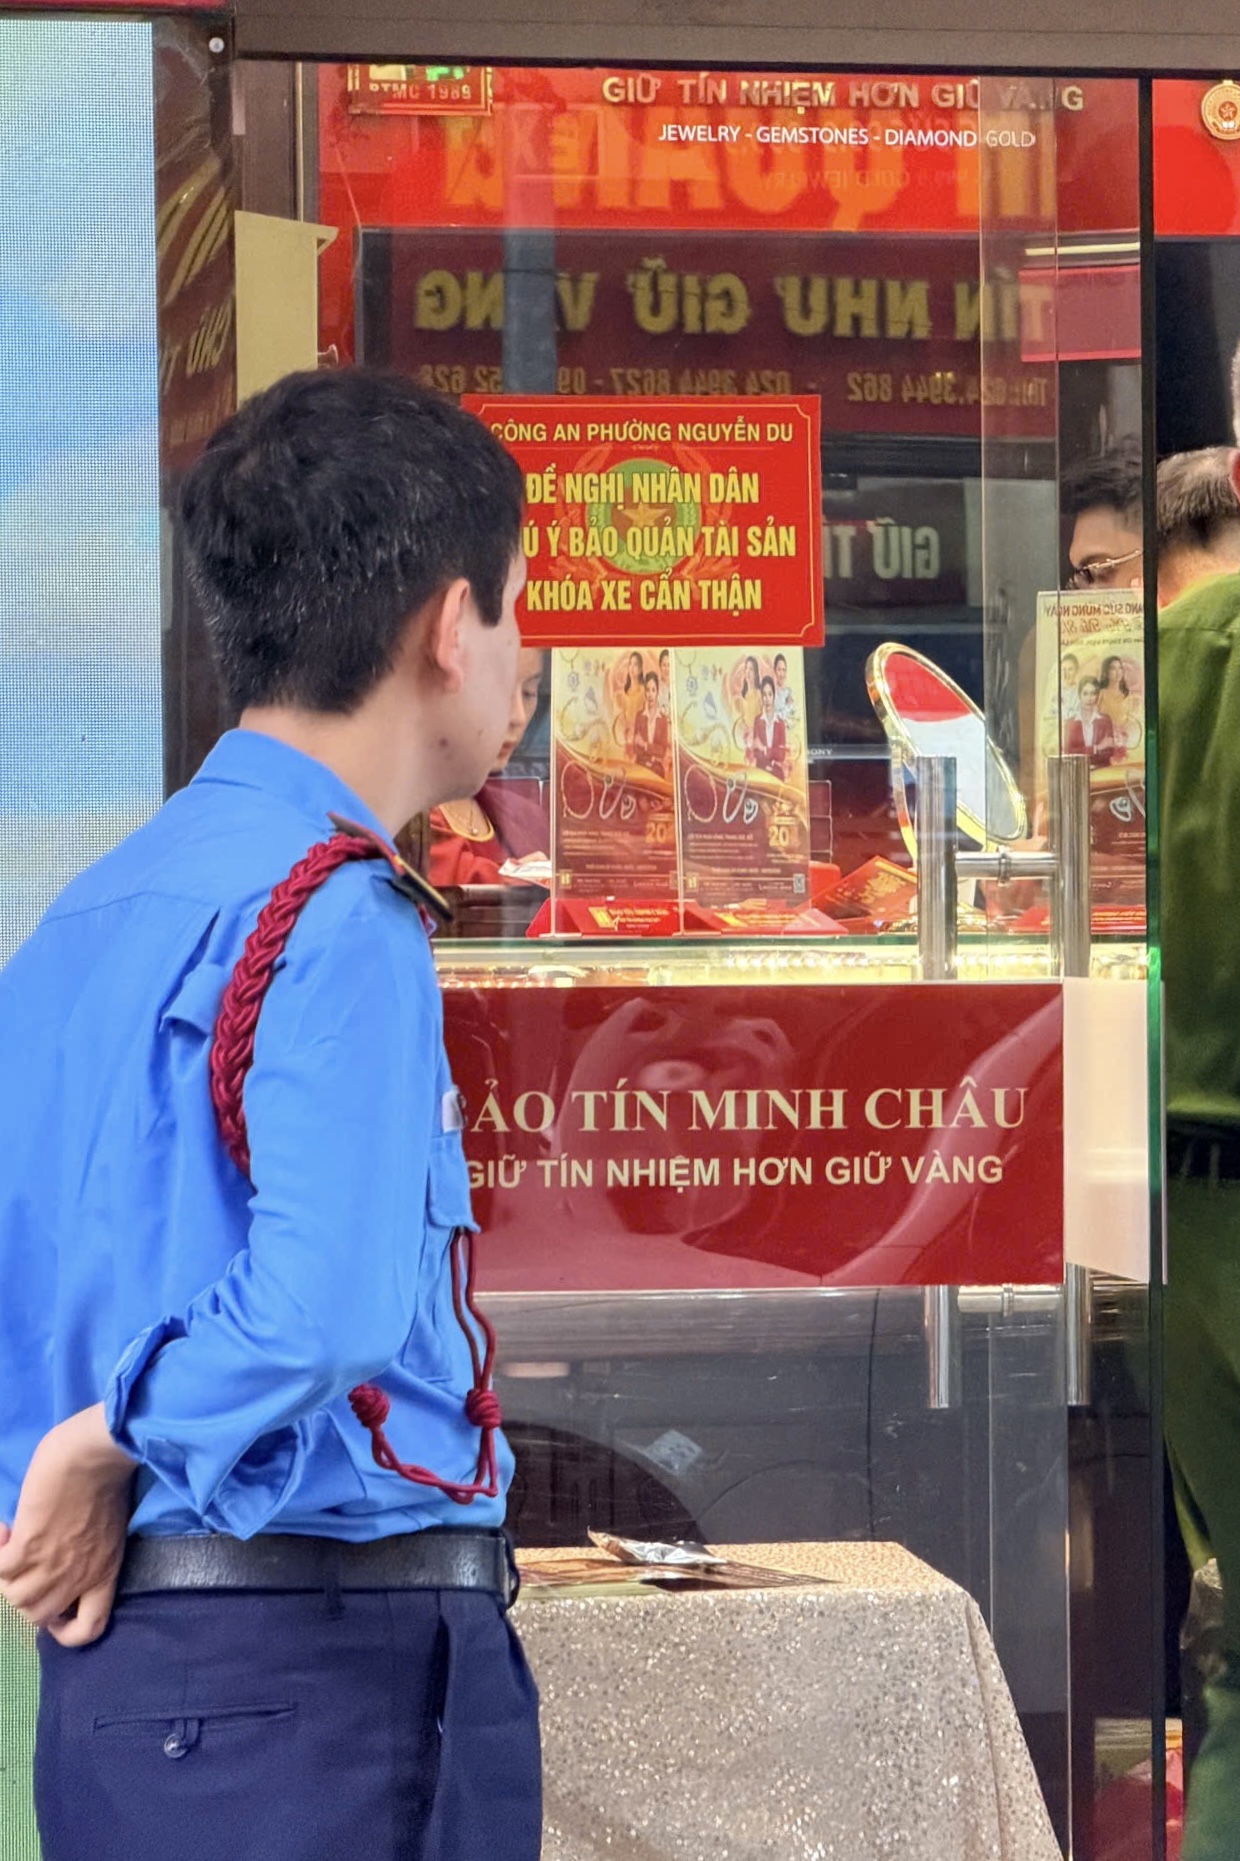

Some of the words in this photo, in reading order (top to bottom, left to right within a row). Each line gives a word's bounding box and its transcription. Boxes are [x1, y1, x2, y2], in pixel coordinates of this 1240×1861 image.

[677, 72, 727, 105] TÍN
[658, 124, 742, 142] JEWELRY
[756, 126, 869, 145] GEMSTONES
[885, 128, 977, 148] DIAMOND
[986, 130, 1036, 148] GOLD
[554, 422, 580, 442] AN
[587, 417, 672, 442] PHƯỜNG
[678, 415, 760, 442] NGUYỄN
[767, 422, 794, 442] DU
[565, 472, 624, 510] NGHỊ
[632, 465, 701, 504] NHÂN
[710, 465, 760, 504] DÂN
[547, 520, 562, 557] Ý
[569, 516, 618, 558] BẢO
[626, 515, 694, 560] QUẢN
[702, 518, 739, 557] TÀI
[747, 515, 796, 557] SẢN
[527, 573, 594, 611] KHÓA
[601, 579, 632, 611] XE
[640, 567, 691, 611] CẨN
[698, 573, 762, 616] THẬN
[806, 748, 832, 756] ONY
[469, 1078, 556, 1133] ẢO
[571, 1077, 669, 1132] TÍN
[688, 1087, 846, 1132] MINH
[864, 1075, 1027, 1131] CHÂU
[467, 1153, 527, 1190] GIỮ
[537, 1151, 593, 1189] TÍN
[606, 1152, 721, 1194] NHIỆM
[732, 1155, 813, 1188] HƠN
[825, 1152, 892, 1187] GIỮ
[901, 1149, 1004, 1185] VÀNG
